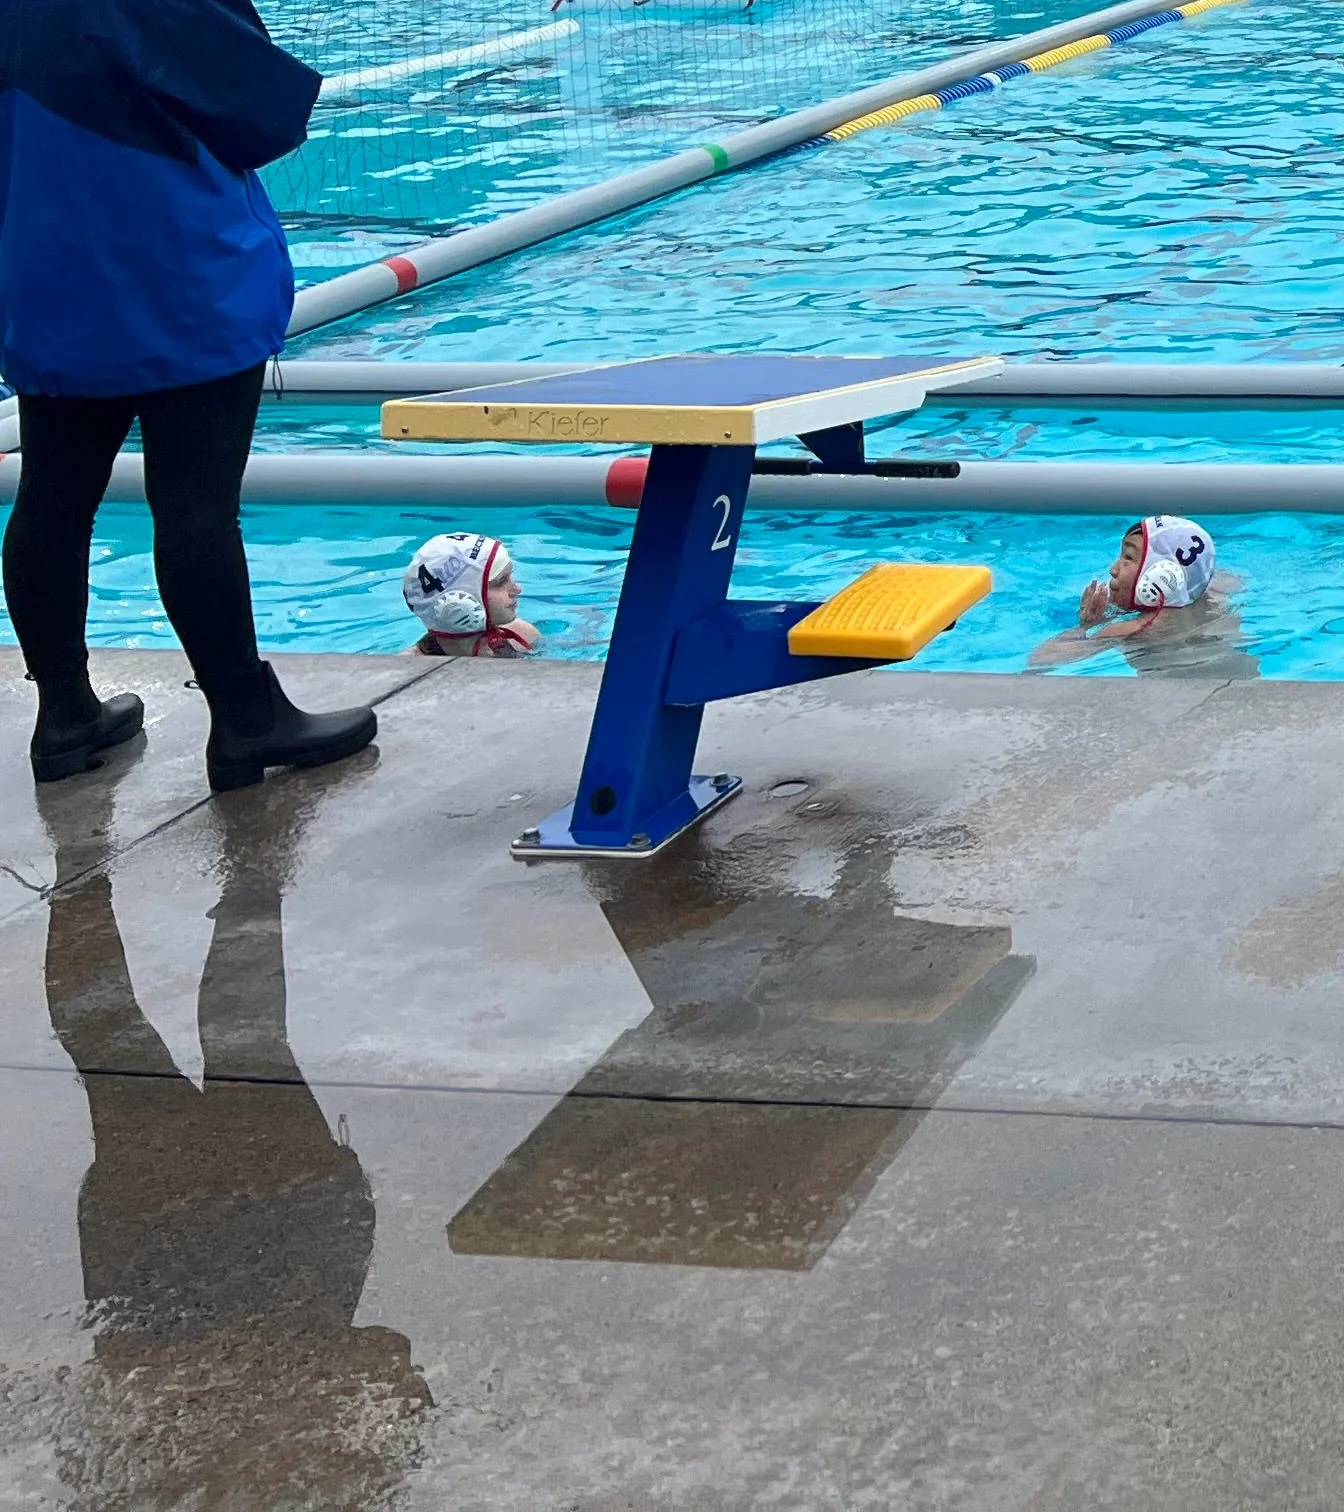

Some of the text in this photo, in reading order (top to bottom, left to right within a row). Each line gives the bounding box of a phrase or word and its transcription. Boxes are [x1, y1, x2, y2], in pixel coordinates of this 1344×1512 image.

[527, 410, 610, 437] Kiefer
[710, 494, 732, 552] 2
[1175, 535, 1206, 567] 3
[417, 563, 446, 594] 4
